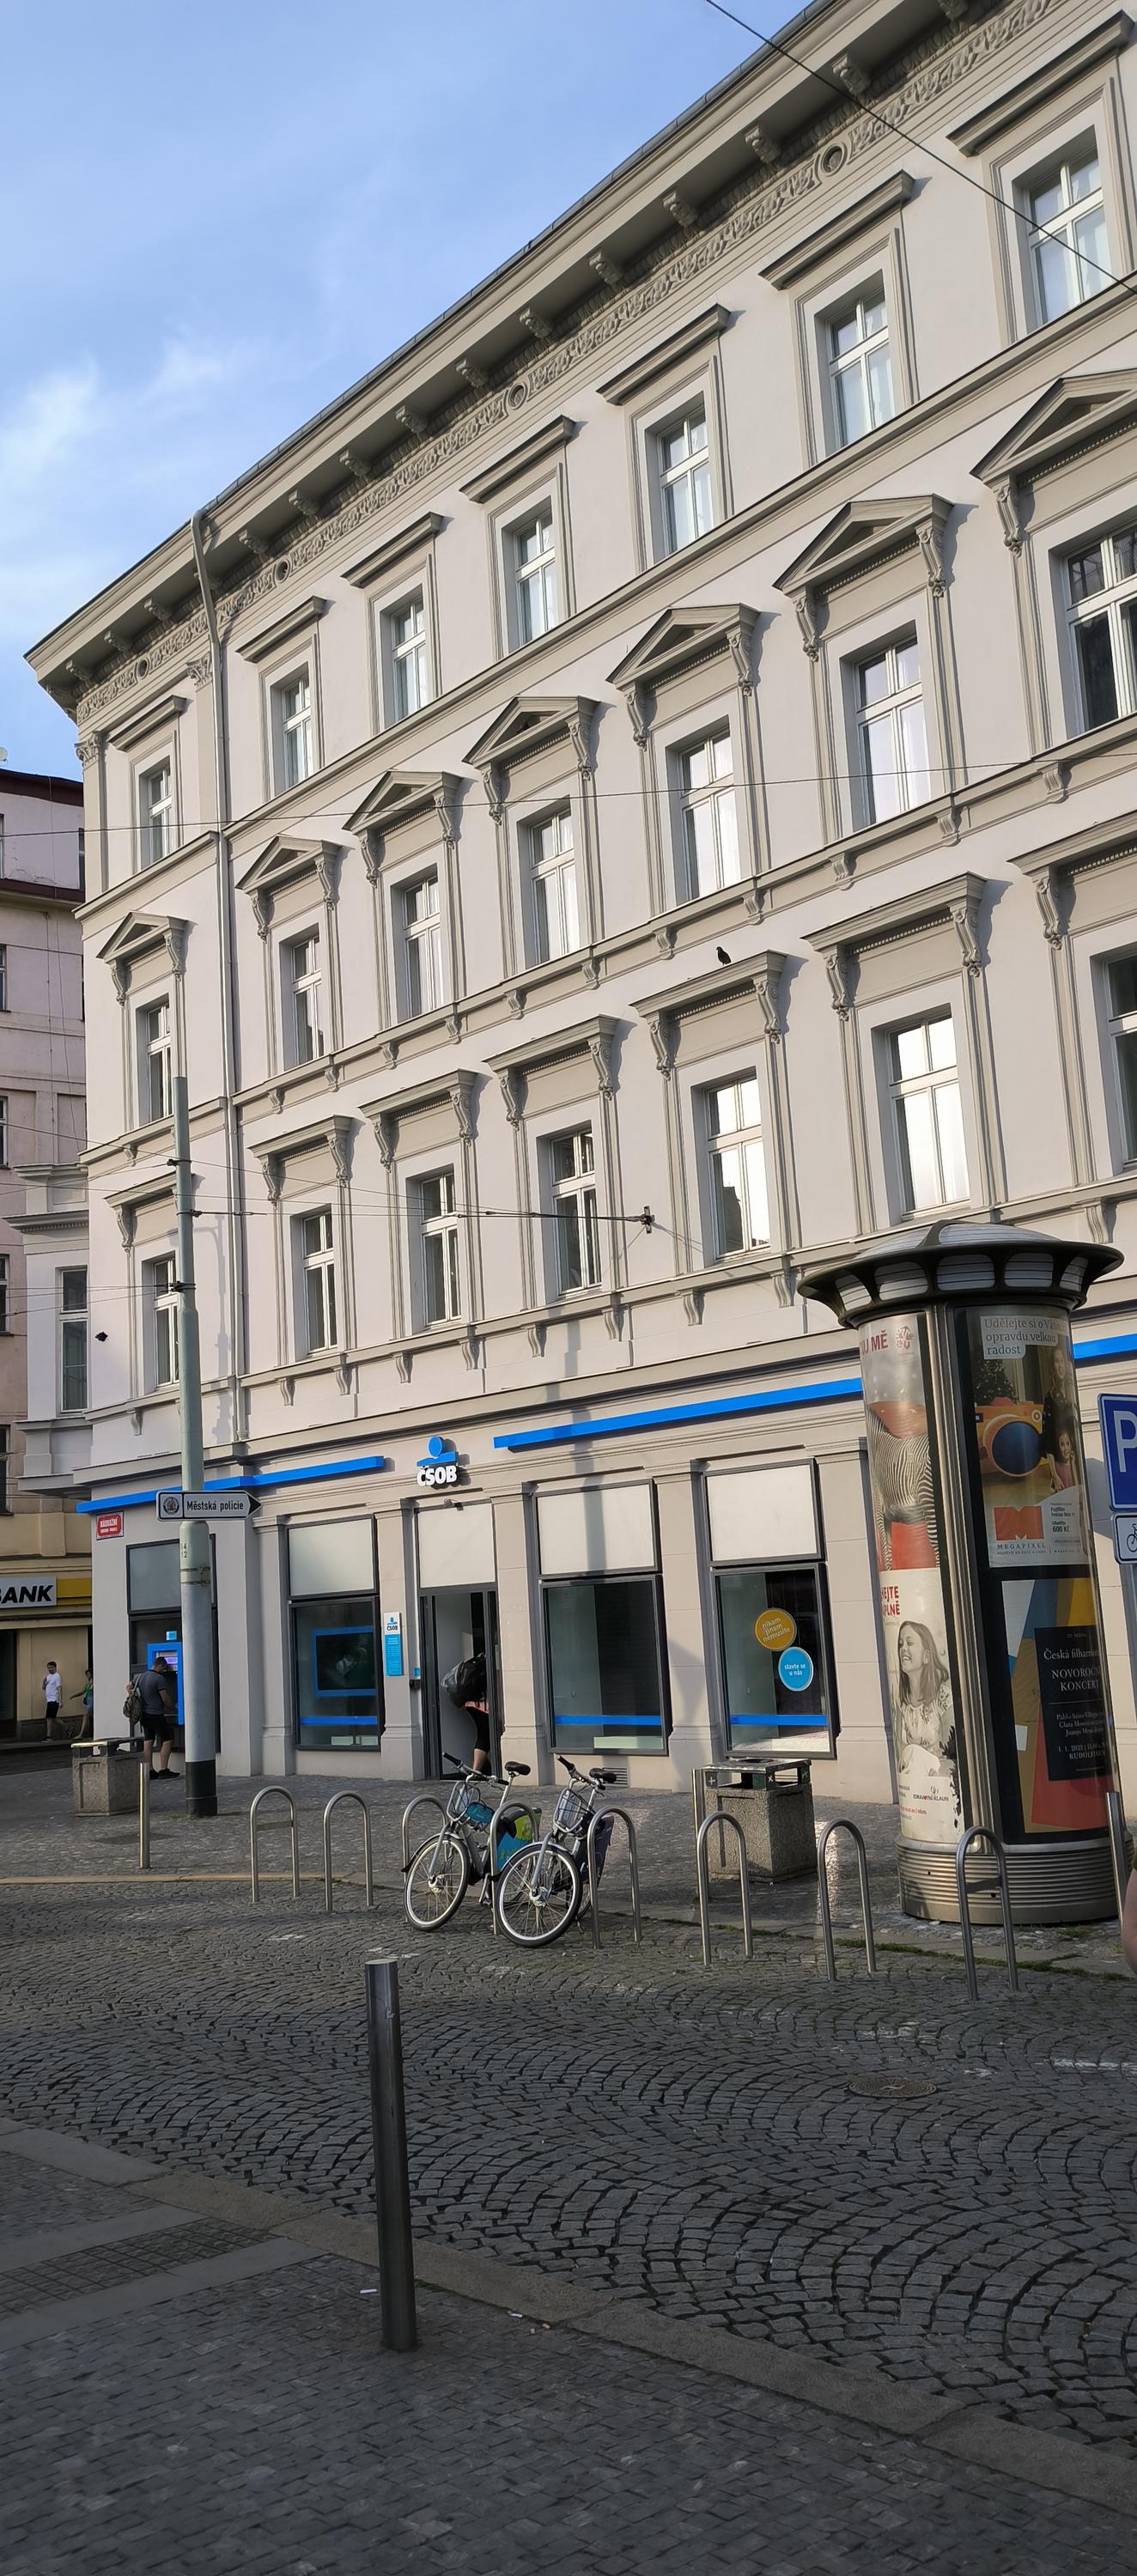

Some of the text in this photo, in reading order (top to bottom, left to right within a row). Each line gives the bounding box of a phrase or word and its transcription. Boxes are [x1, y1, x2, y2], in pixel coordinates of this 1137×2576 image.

[984, 1318, 1027, 1330] Udělejte
[1029, 1318, 1037, 1329] si
[871, 1328, 889, 1352] MĚ
[985, 1331, 1056, 1344] opravdu velkou
[988, 1345, 1021, 1355] radost
[1113, 1410, 1137, 1473] P
[416, 1464, 458, 1487] ČSOB
[186, 1501, 244, 1512] Městská policie
[0, 1585, 53, 1604] ANK
[762, 1617, 781, 1629] nikam
[765, 1624, 783, 1636] jinam
[1043, 1649, 1069, 1660] Česká
